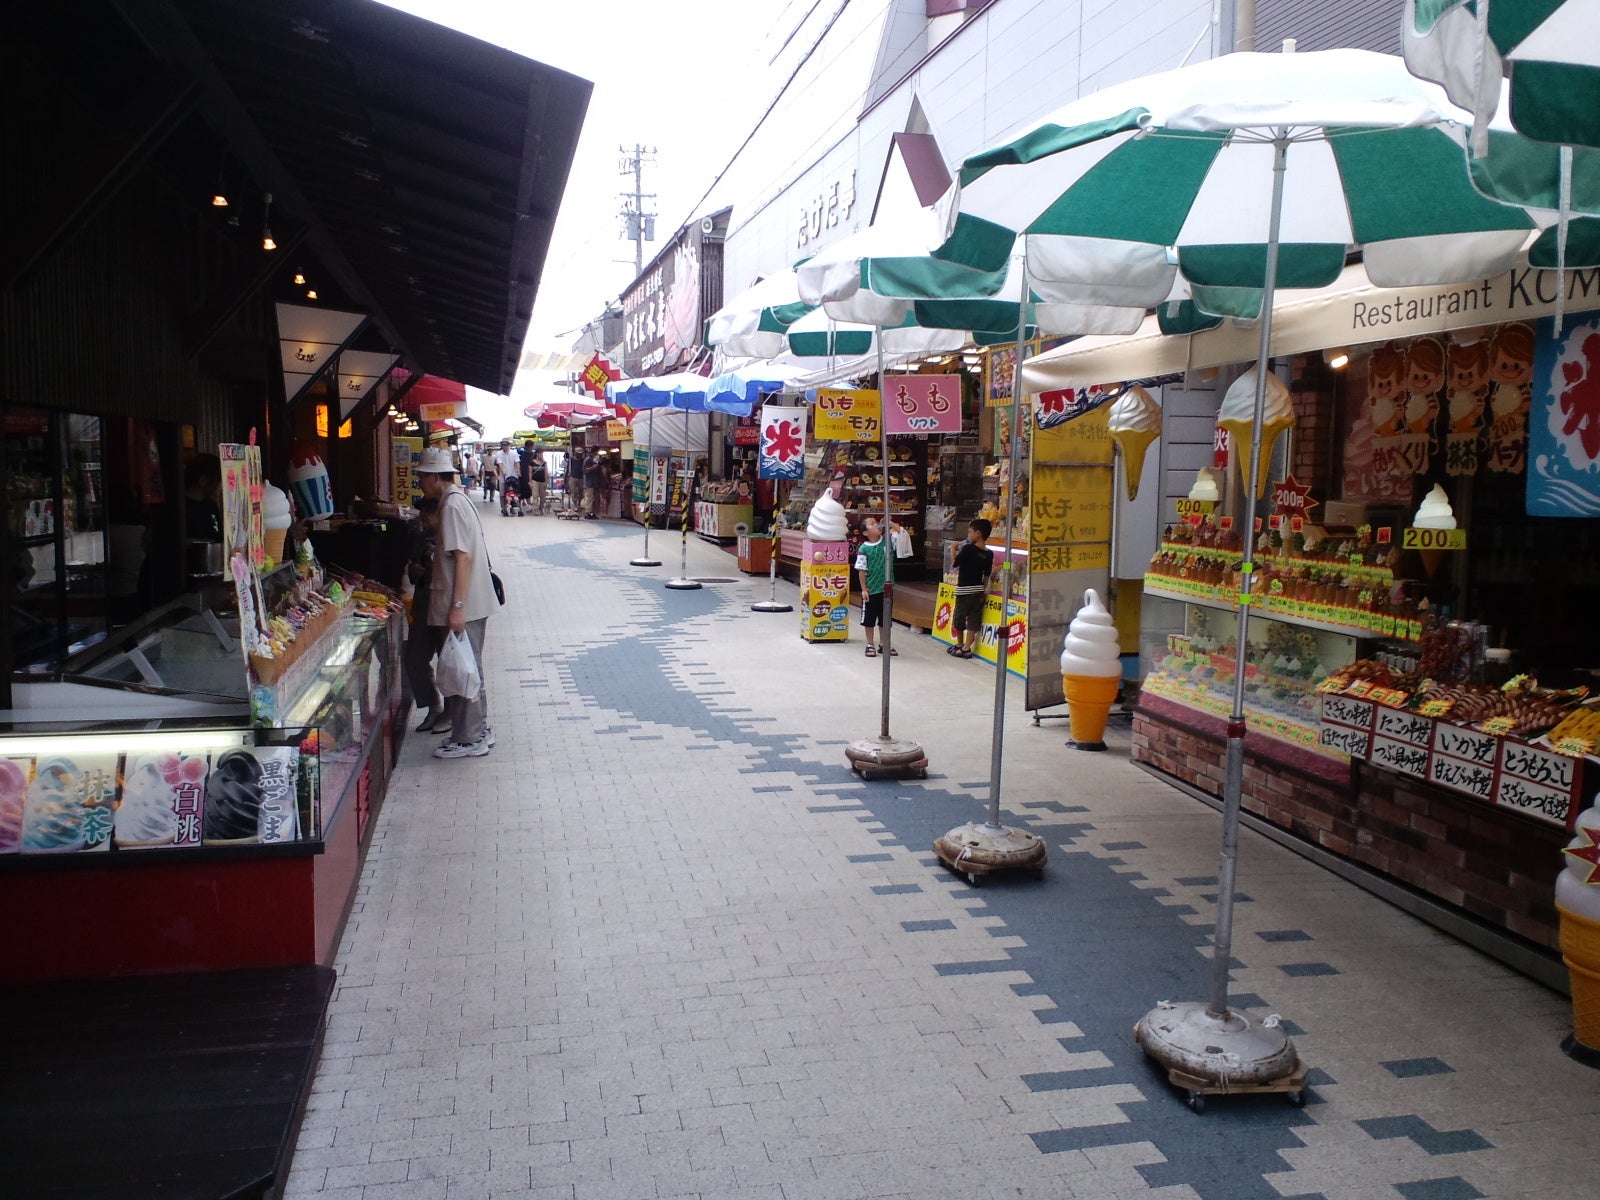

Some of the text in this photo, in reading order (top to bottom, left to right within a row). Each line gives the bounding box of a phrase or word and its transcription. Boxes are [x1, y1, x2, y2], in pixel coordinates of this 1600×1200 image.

[1353, 279, 1493, 329] Restaurant
[819, 395, 853, 410] いも
[896, 384, 949, 414] もも
[847, 415, 878, 431] モカ
[908, 417, 939, 429] ソフト
[765, 420, 803, 463] 氷
[1403, 440, 1428, 473] くり
[396, 466, 410, 501] 甘えび
[1276, 489, 1304, 508] 200円
[824, 546, 847, 562] もも
[813, 576, 847, 590] いも
[1380, 713, 1432, 746] たこの串焼
[1441, 731, 1496, 765] いか焼
[1504, 750, 1573, 788] とうもろこし
[77, 767, 115, 843] 抹茶
[173, 783, 201, 844] 白桃
[258, 758, 285, 842] 黒ごま
